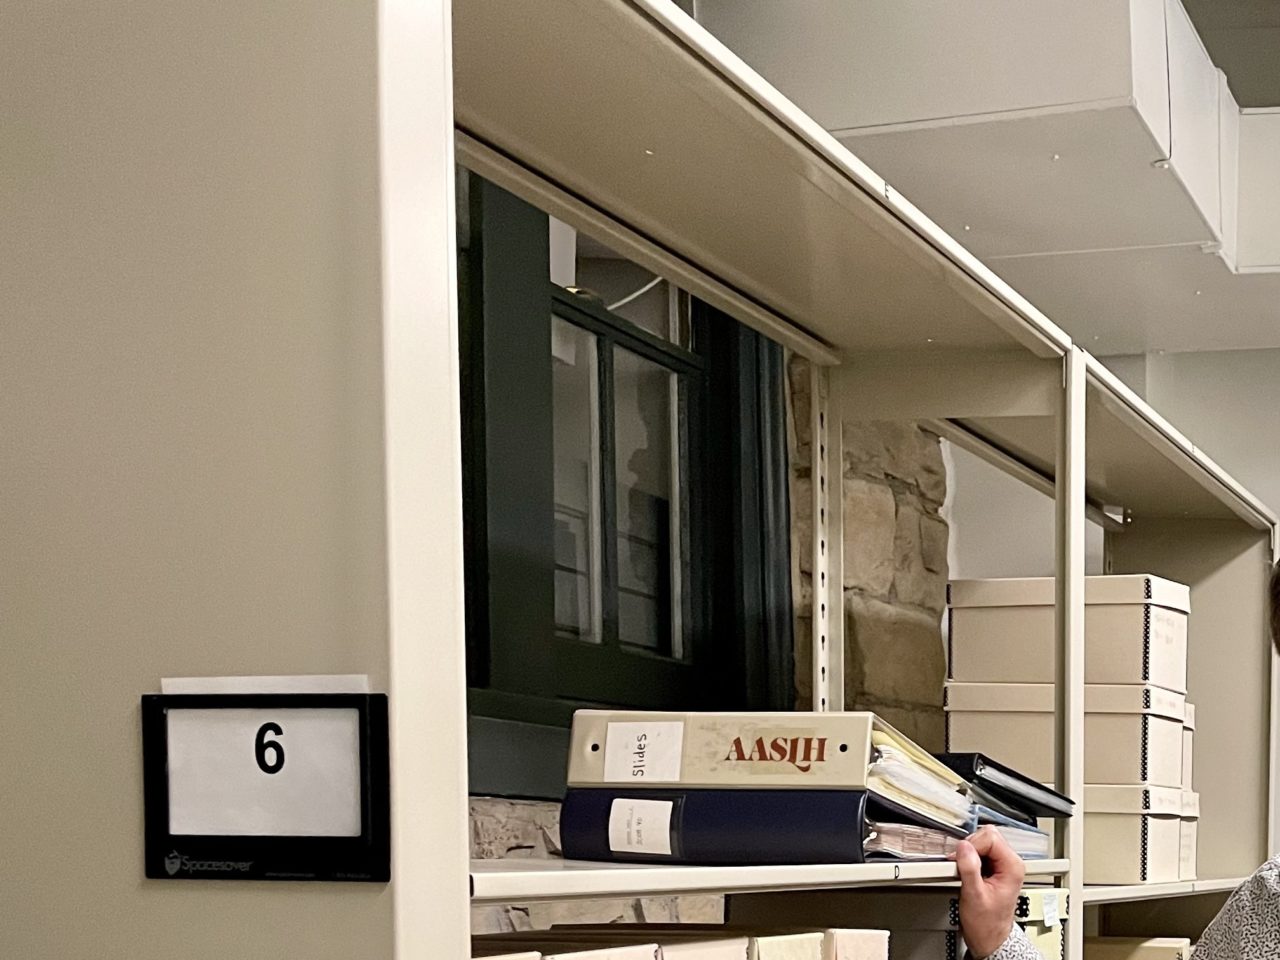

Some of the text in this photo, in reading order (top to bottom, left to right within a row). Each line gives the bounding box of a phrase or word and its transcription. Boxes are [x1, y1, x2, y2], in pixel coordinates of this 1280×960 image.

[255, 722, 285, 774] 6
[632, 734, 647, 776] Slides
[724, 736, 828, 773] AASLH
